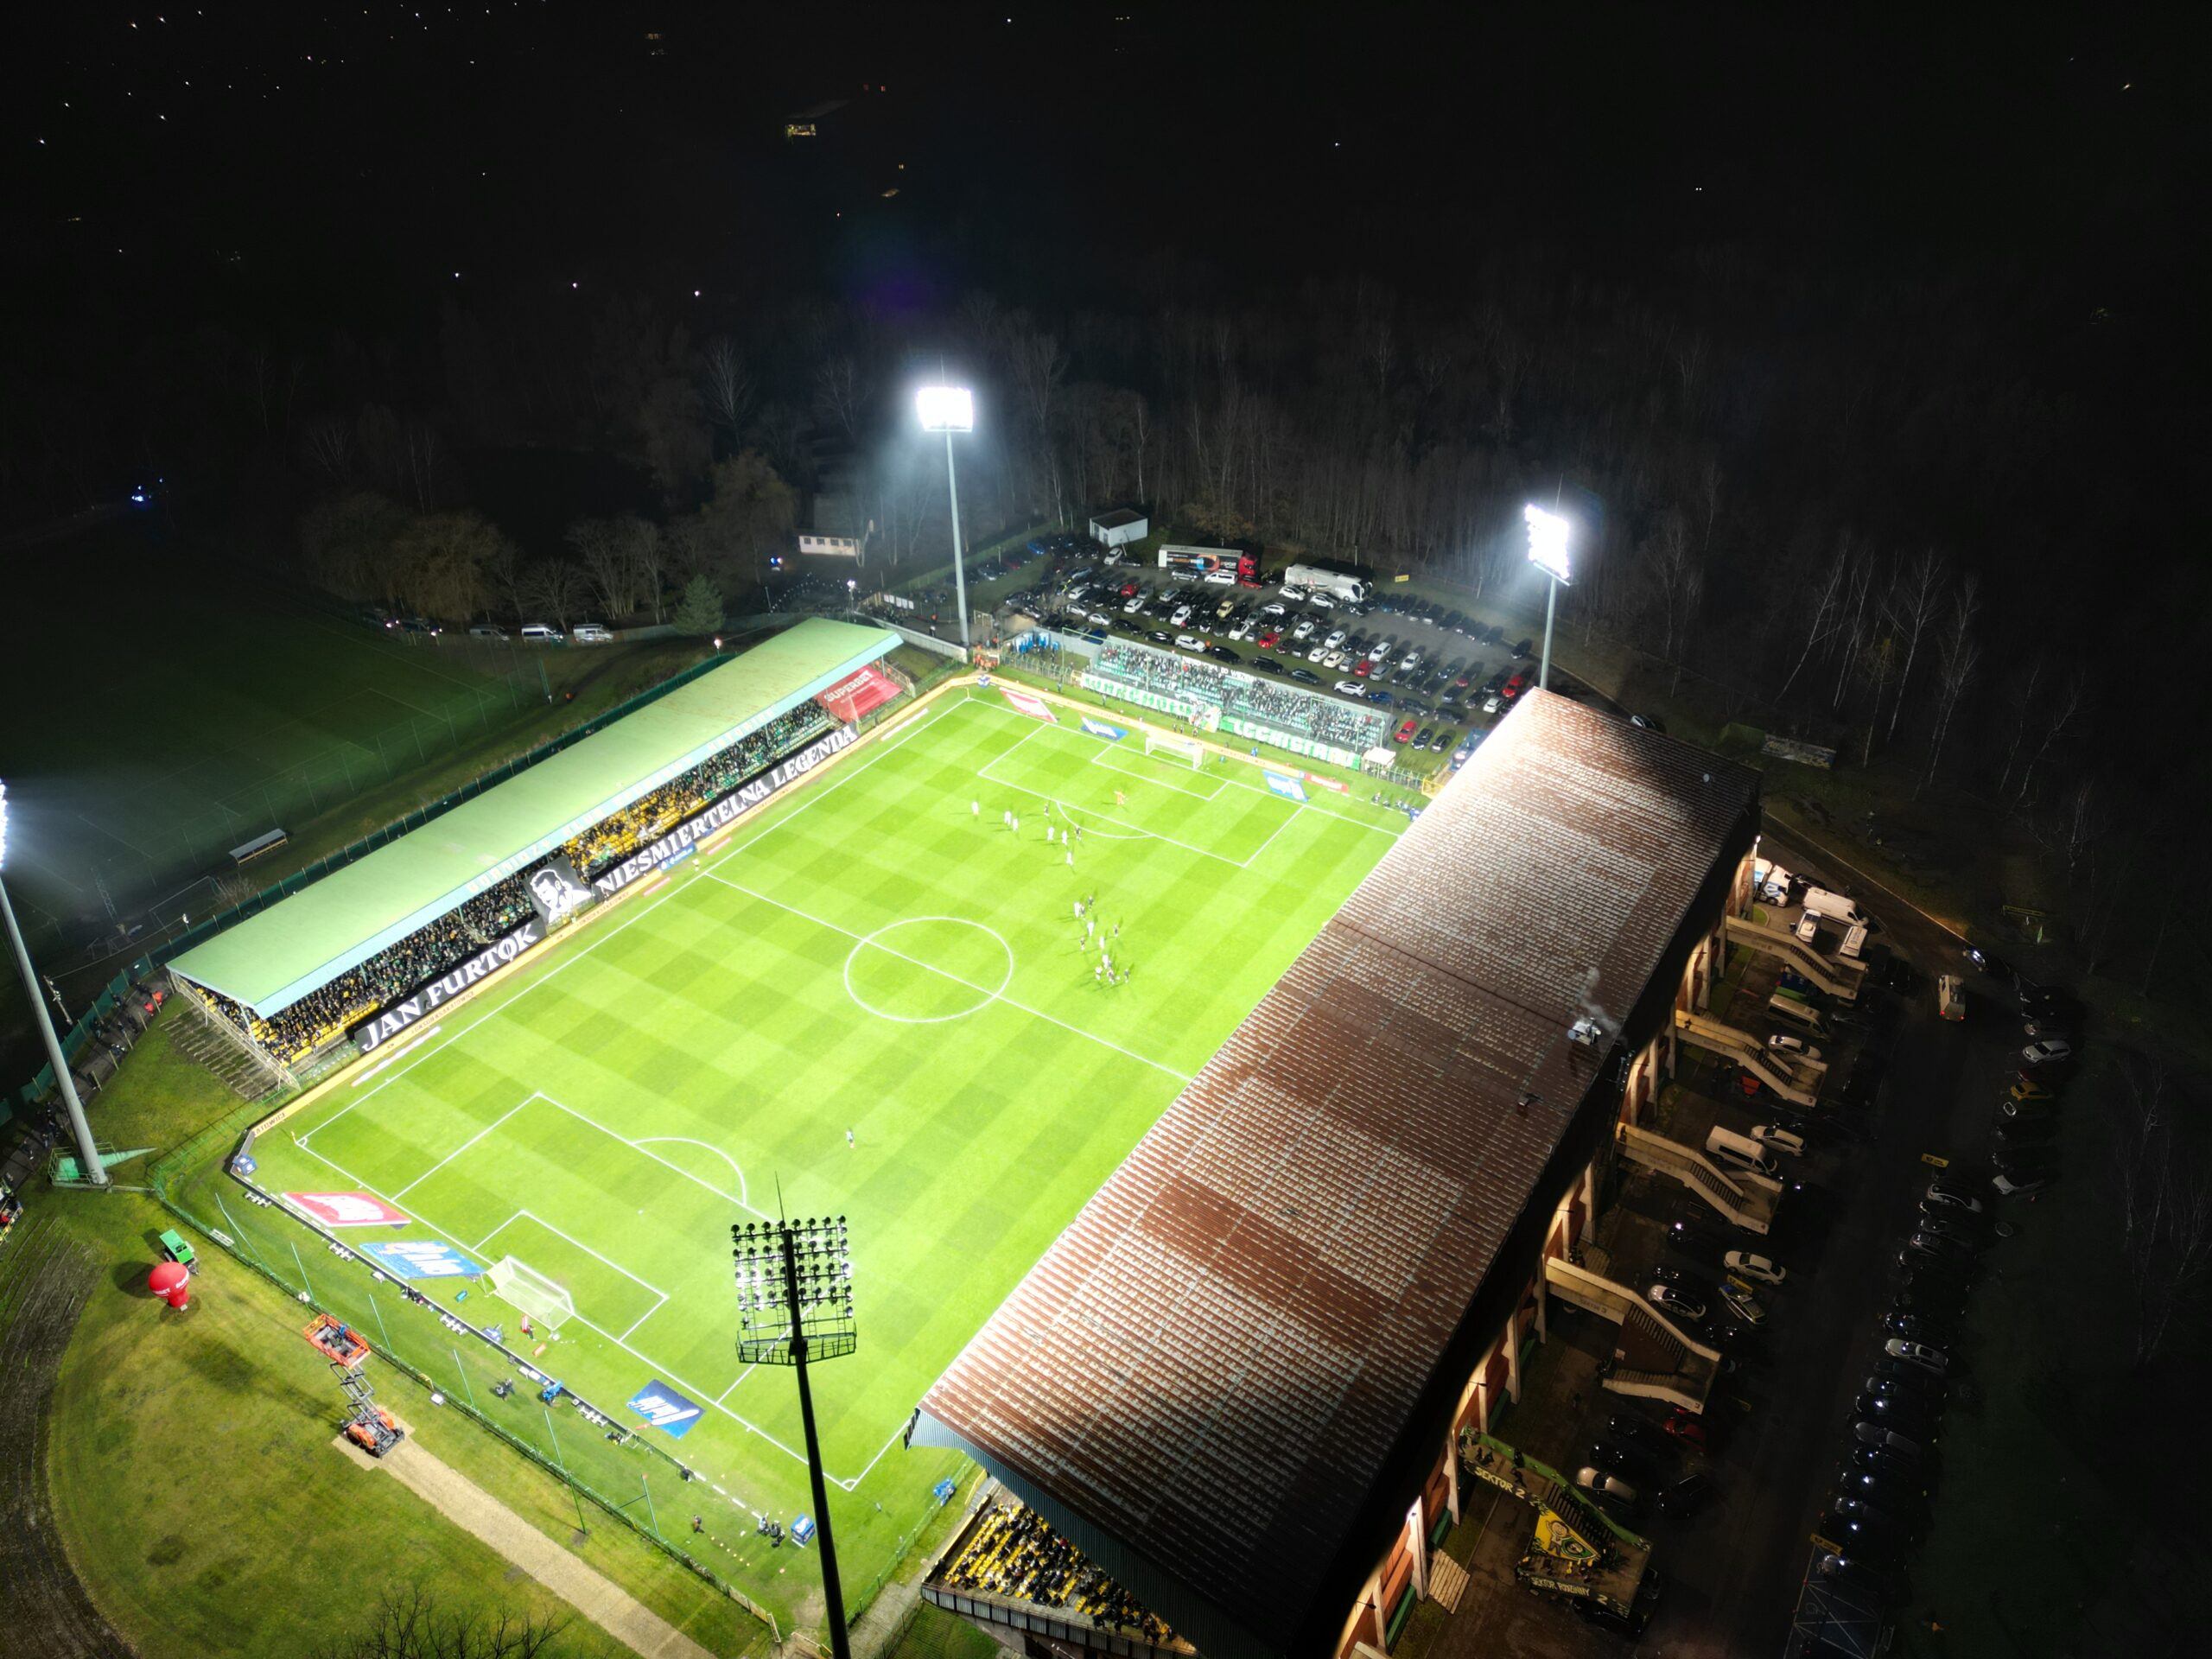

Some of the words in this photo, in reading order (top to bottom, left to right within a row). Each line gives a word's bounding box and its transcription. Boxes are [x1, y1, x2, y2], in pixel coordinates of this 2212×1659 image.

[824, 671, 873, 702] SUPERBET
[771, 725, 858, 787] LEGENDA
[362, 996, 421, 1052] JAN
[426, 924, 537, 1007] FURTOK
[1474, 1466, 1514, 1492] SEKTOR
[1515, 1486, 1526, 1499] 2
[1531, 1577, 1556, 1589] SEKTOR
[1597, 1594, 1607, 1605] 2
